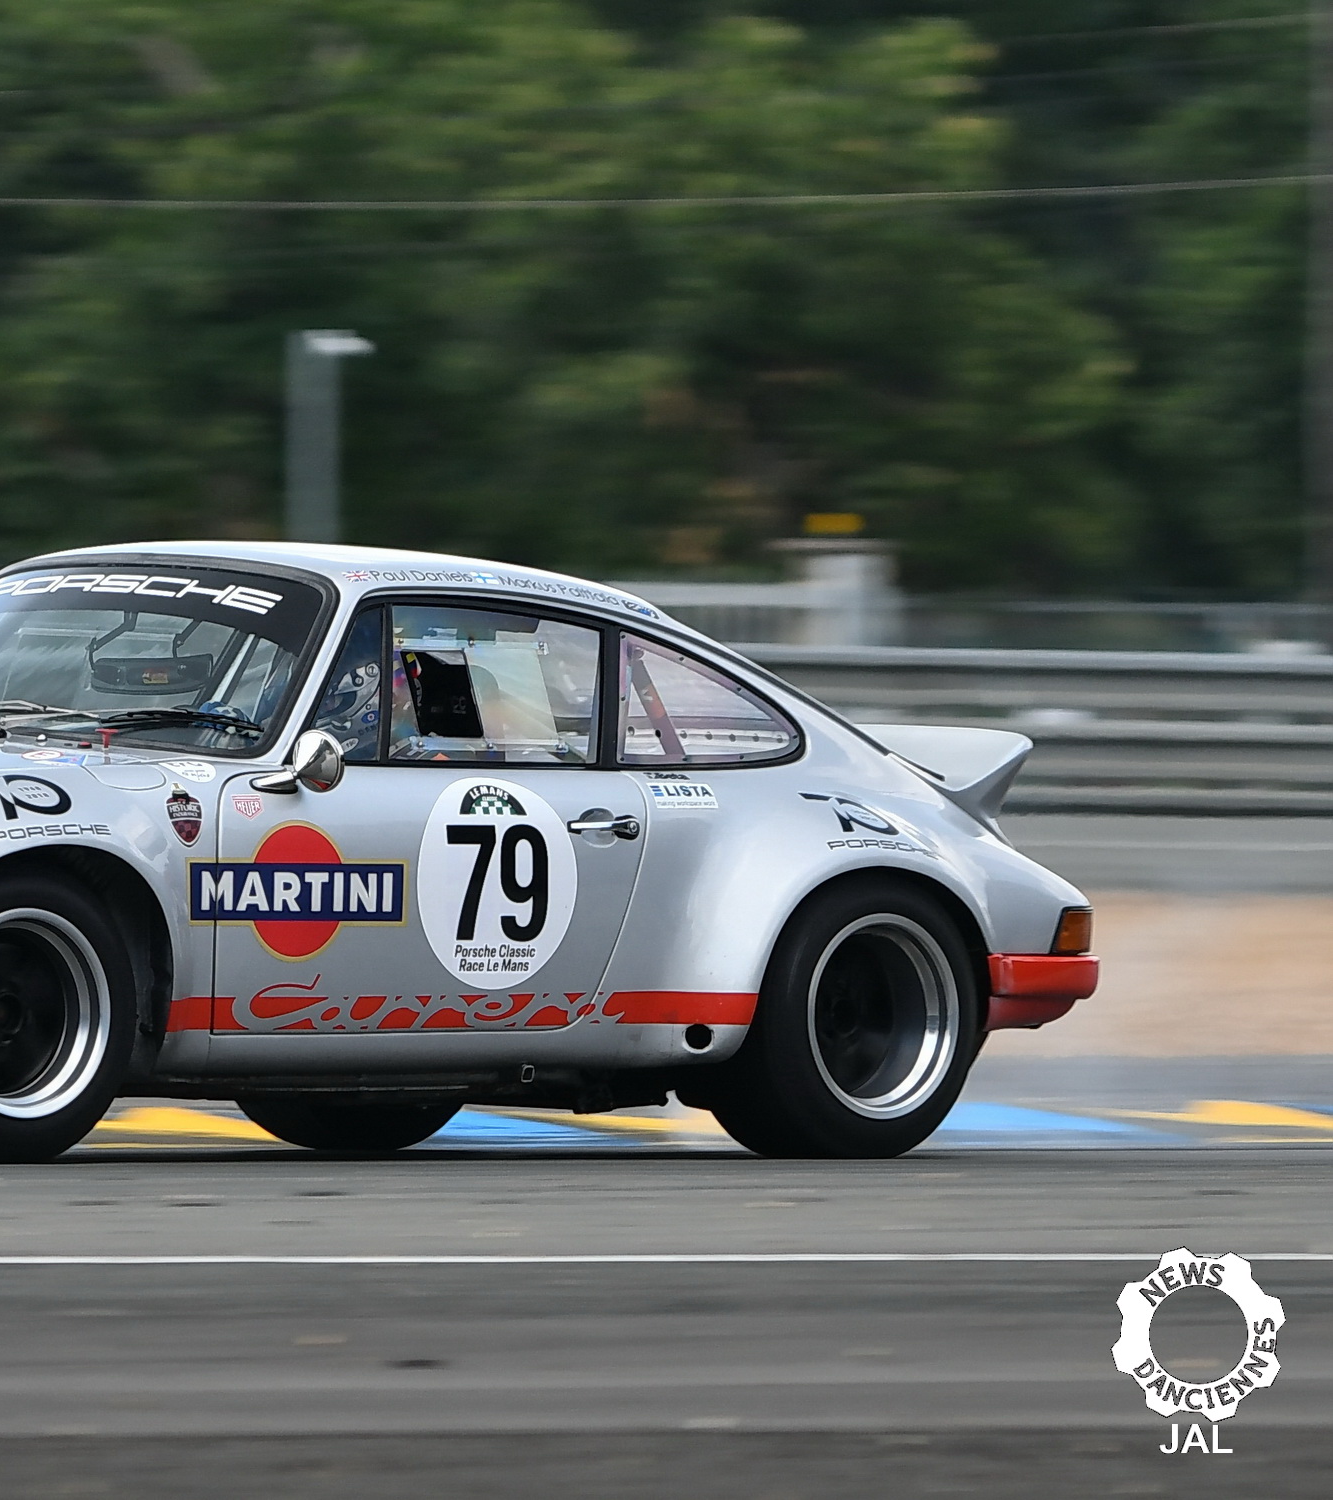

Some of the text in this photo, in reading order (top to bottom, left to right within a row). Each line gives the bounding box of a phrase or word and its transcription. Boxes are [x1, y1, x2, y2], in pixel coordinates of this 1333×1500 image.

[369, 570, 473, 583] Paul Daniels
[498, 575, 557, 593] Markus
[663, 785, 714, 797] LISTA
[235, 801, 261, 817] HEUER
[445, 823, 549, 942] 79
[200, 870, 394, 913] MARTINI
[454, 944, 536, 958] Porsche Classic
[458, 958, 530, 972] Race Le Mans
[231, 973, 625, 1031] Carrera
